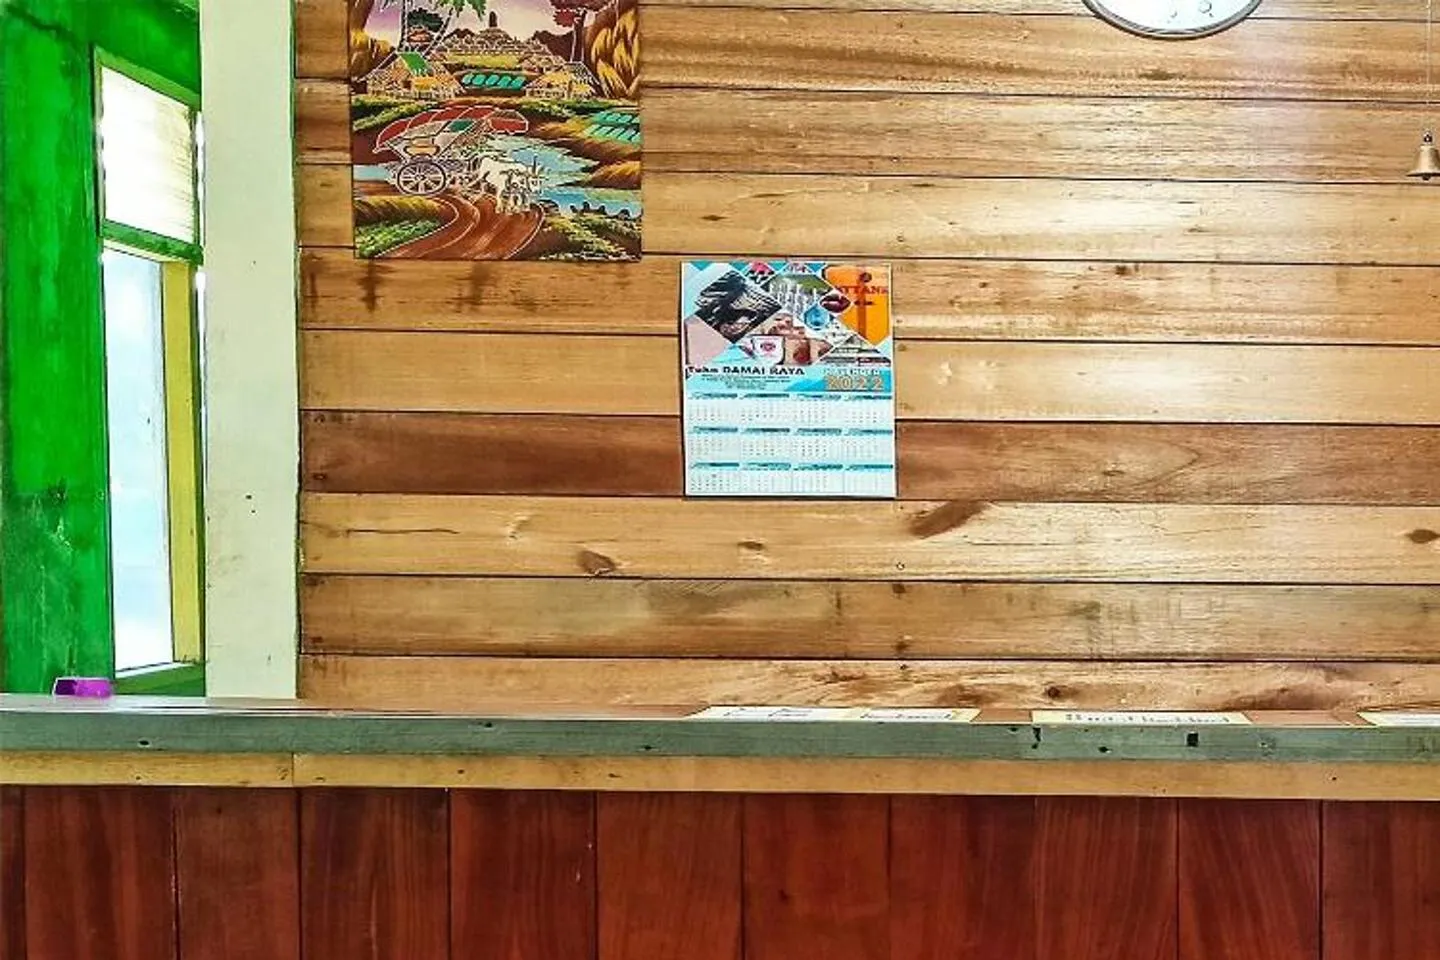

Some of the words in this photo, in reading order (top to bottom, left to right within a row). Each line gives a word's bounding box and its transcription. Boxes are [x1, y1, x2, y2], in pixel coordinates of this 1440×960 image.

[722, 366, 766, 375] DAMAI
[769, 366, 806, 376] RAYA
[829, 375, 884, 390] 2022
